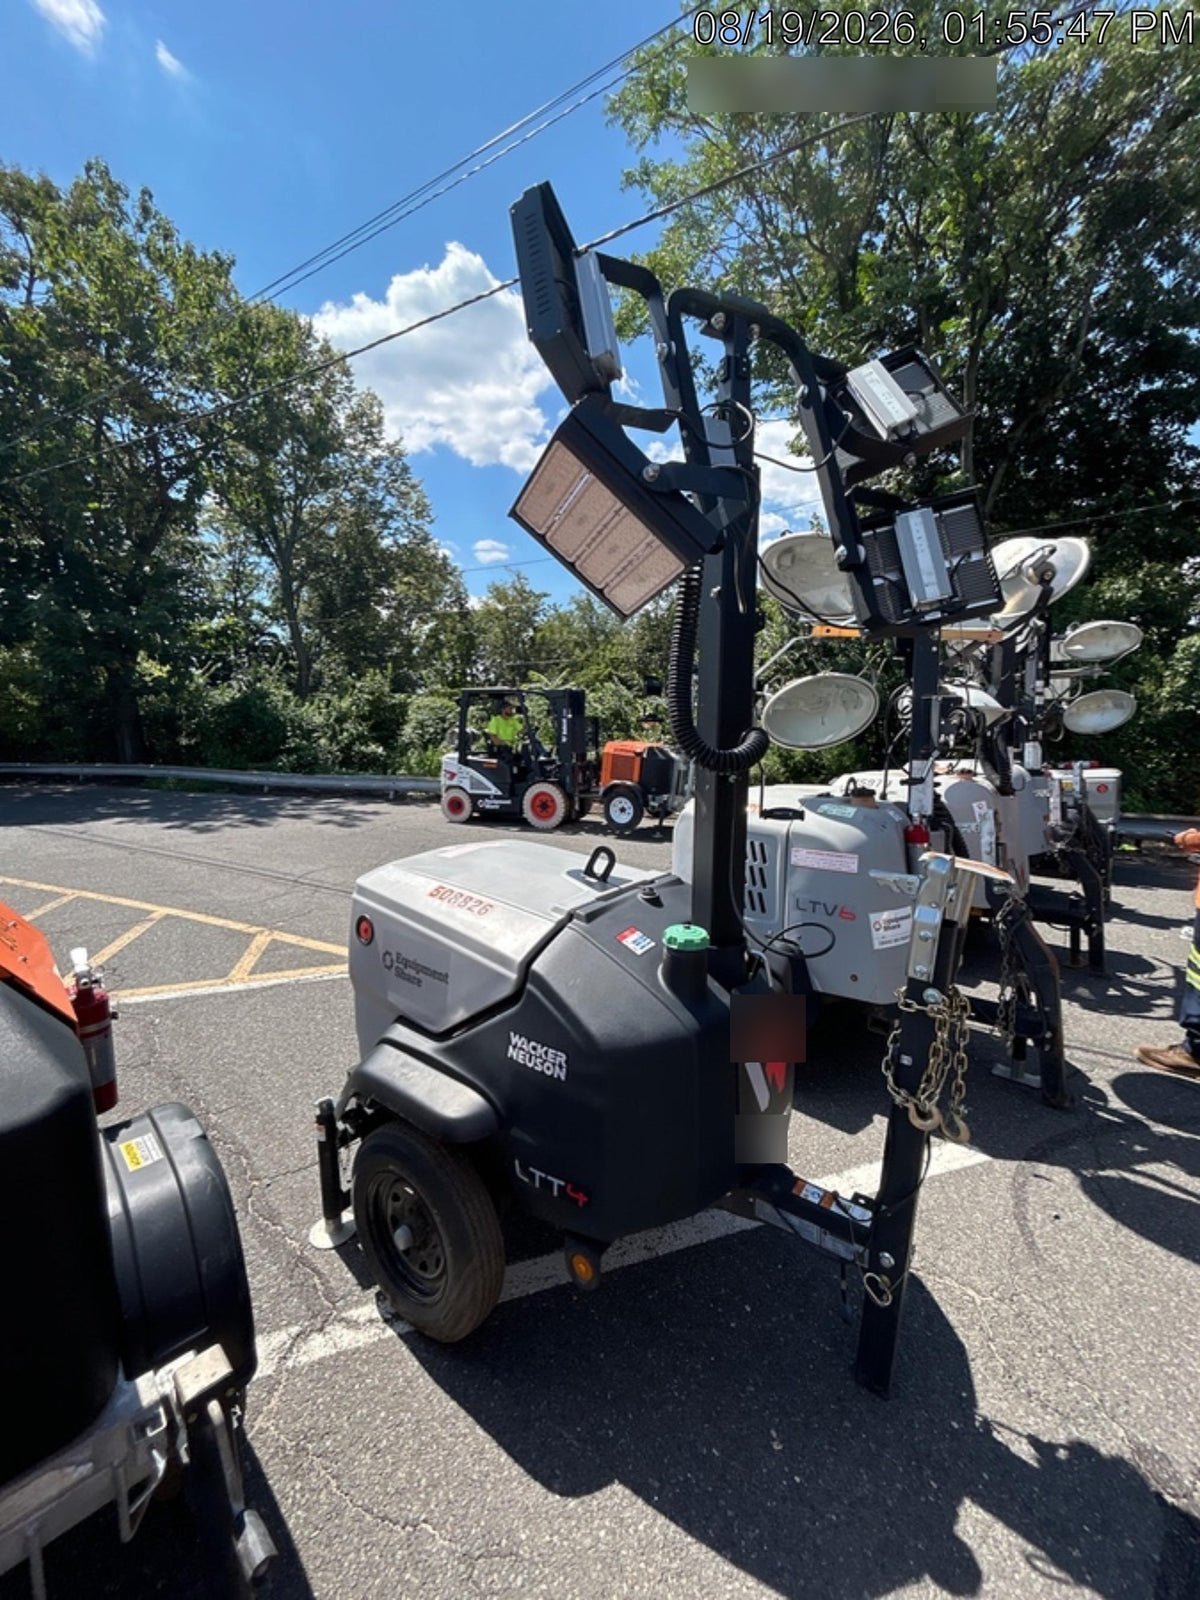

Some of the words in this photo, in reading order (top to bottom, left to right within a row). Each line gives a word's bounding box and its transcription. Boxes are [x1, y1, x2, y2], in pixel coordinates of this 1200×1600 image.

[394, 965, 423, 987] Share
[395, 951, 449, 985] Equipment
[508, 1045, 566, 1081] NEUSON
[509, 1031, 567, 1068] WACKER
[515, 1159, 589, 1207] LTT4
